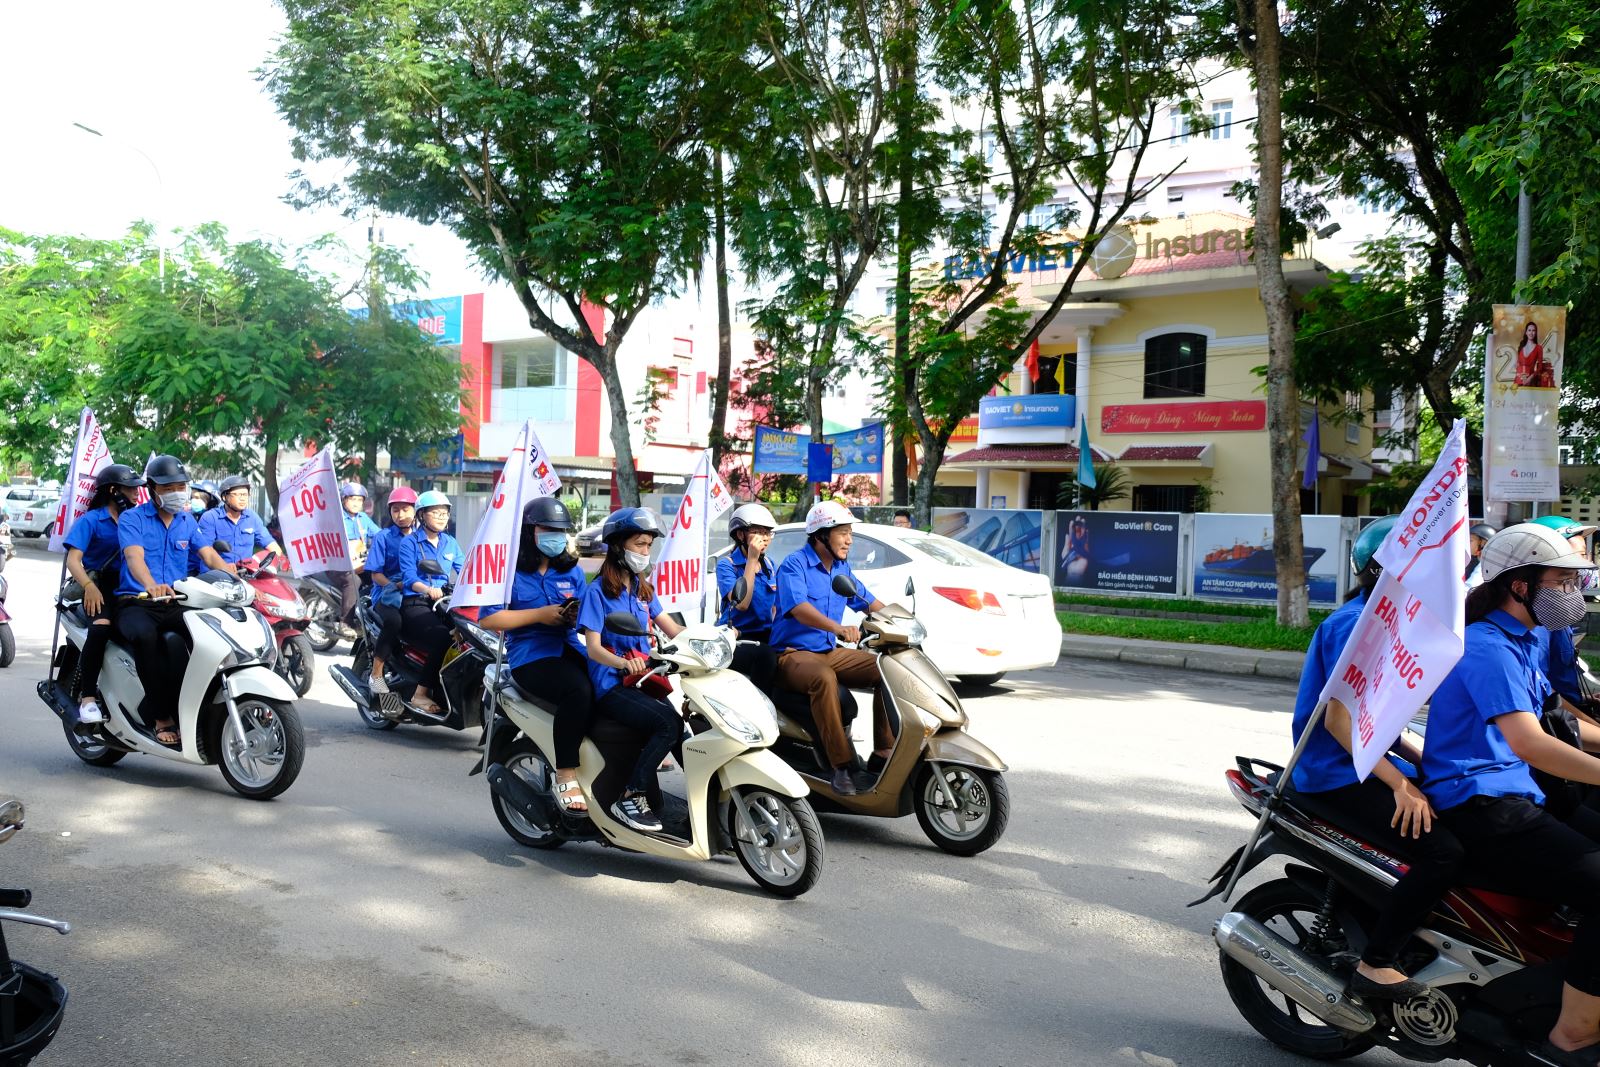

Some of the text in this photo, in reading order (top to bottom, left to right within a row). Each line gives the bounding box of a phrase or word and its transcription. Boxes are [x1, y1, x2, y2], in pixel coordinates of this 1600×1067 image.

[1145, 227, 1250, 260] Insura
[1024, 405, 1059, 413] Insurance
[291, 483, 326, 518] LỘC
[1398, 455, 1469, 549] HONDA
[1114, 521, 1173, 531] BaoViet Care
[1417, 532, 1428, 547] the
[1426, 506, 1446, 533] Power
[1445, 497, 1455, 507] of
[291, 533, 345, 564] THỊNH
